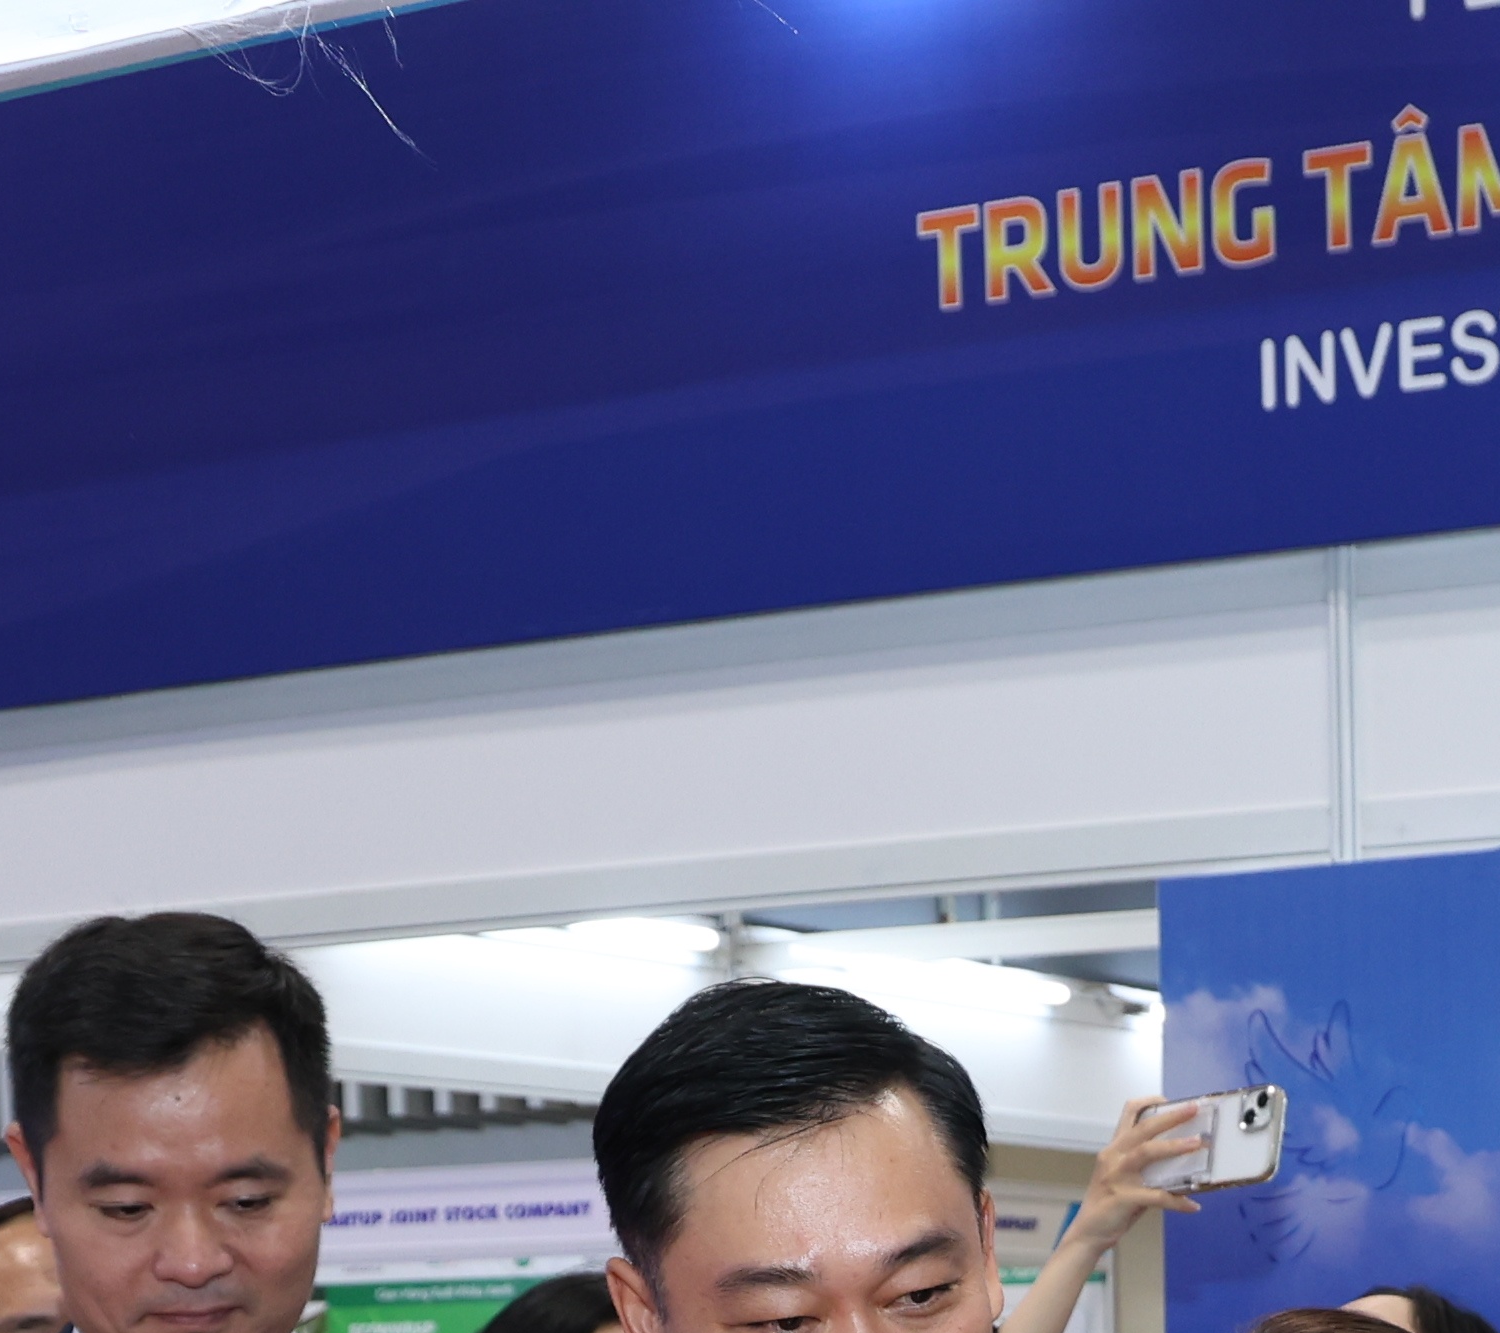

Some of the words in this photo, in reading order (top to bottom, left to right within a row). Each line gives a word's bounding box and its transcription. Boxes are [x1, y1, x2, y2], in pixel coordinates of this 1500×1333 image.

[917, 157, 1274, 310] TRUNG
[445, 1204, 498, 1222] STOCK
[505, 1201, 591, 1218] COMPANY
